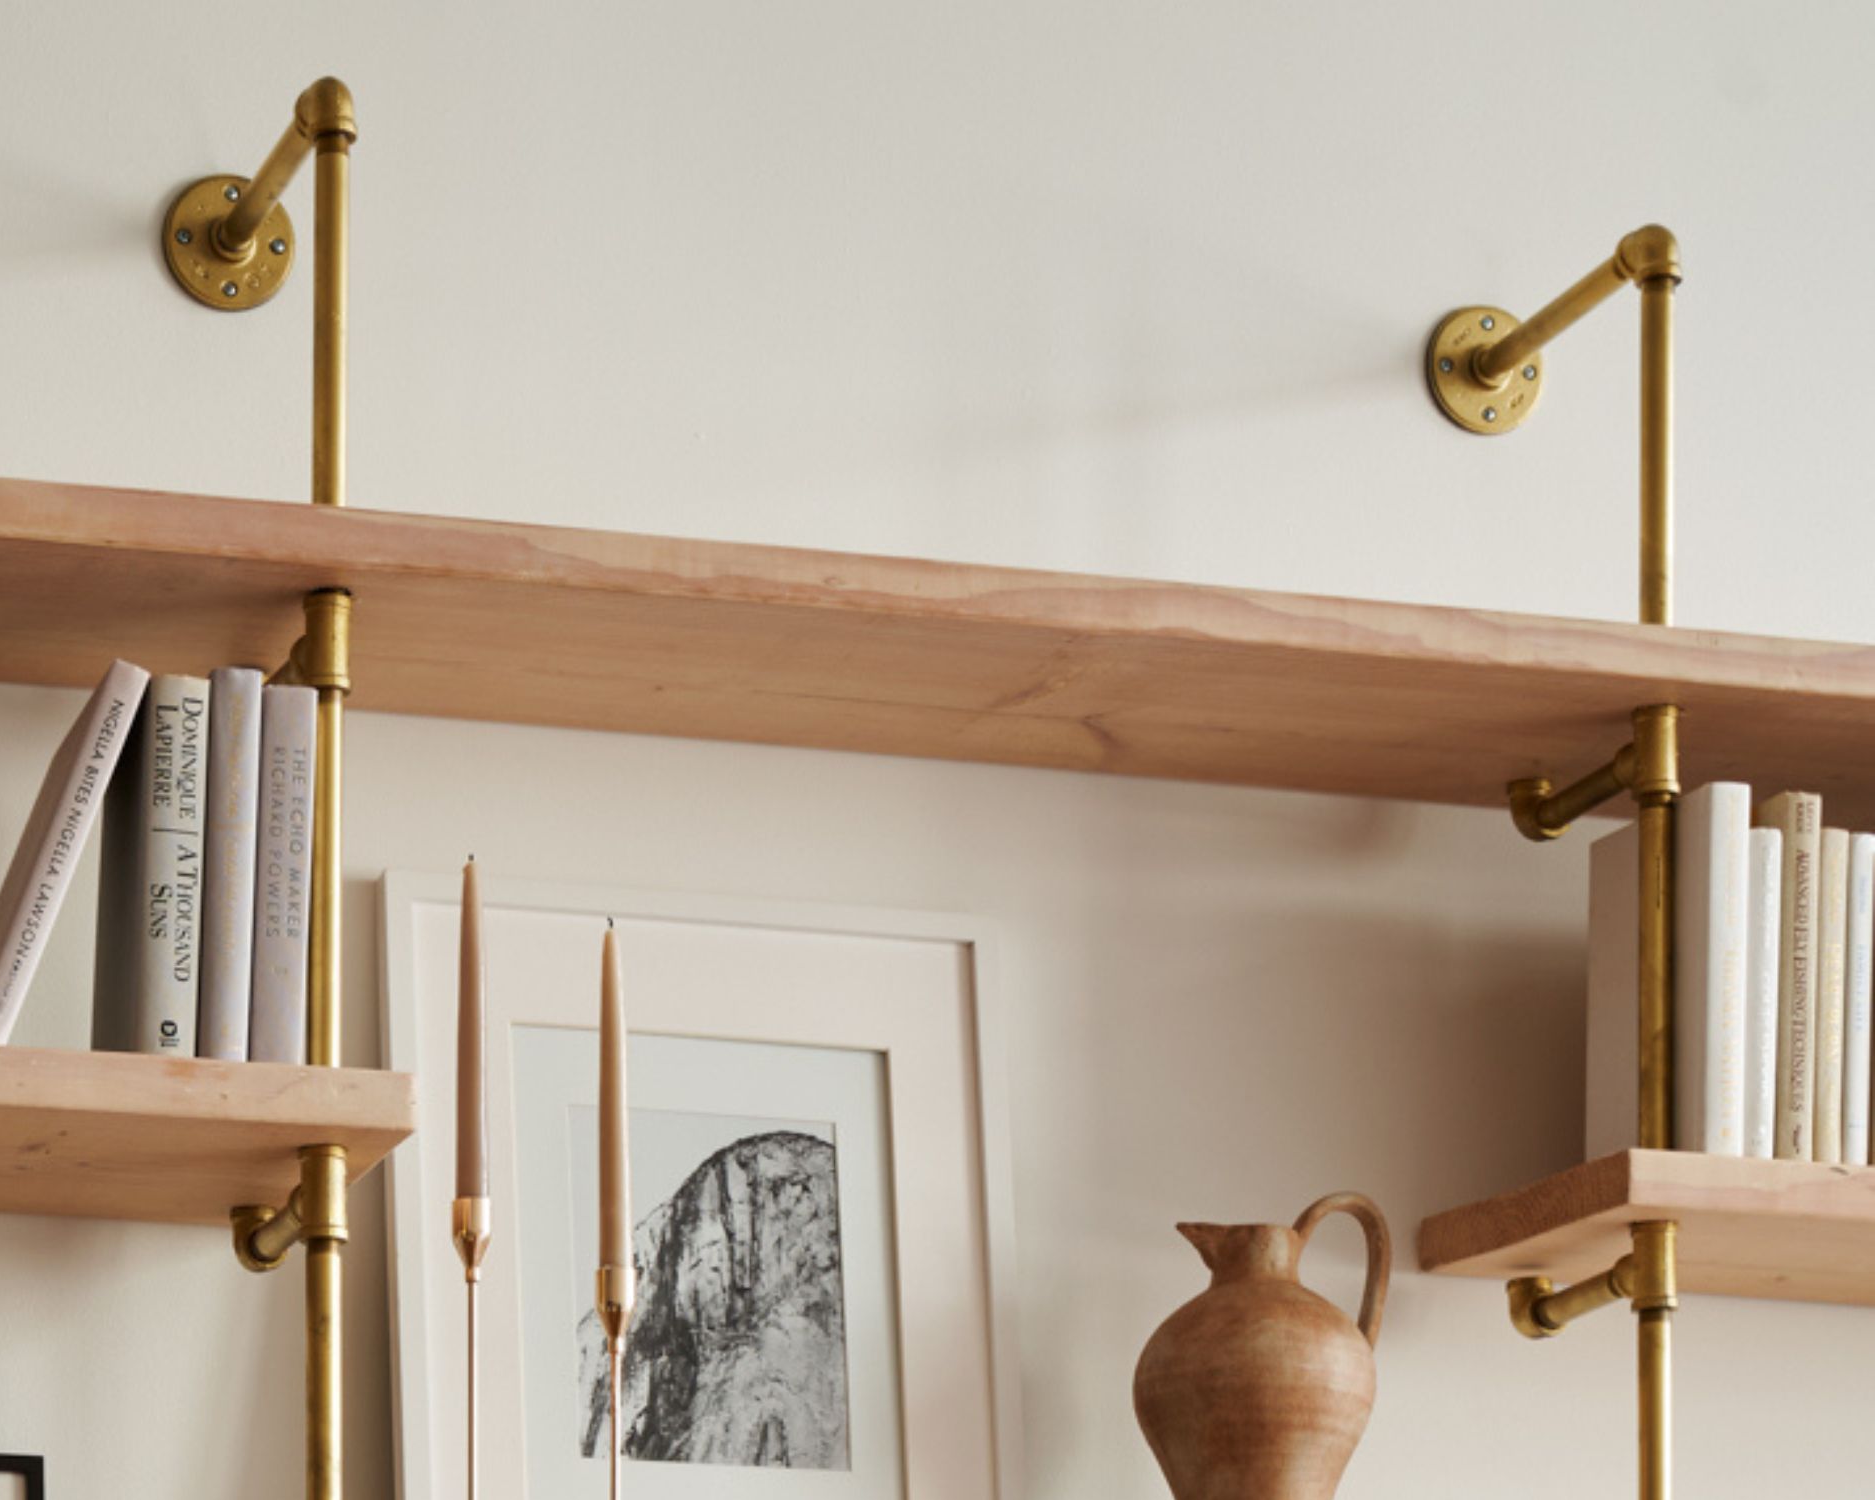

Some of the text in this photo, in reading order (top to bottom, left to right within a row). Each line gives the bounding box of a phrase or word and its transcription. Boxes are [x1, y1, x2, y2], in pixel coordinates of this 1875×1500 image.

[15, 698, 125, 959] NIGELLA BITES NIGELLA LAWSON
[177, 845, 195, 861] A
[264, 745, 285, 939] RICHARD POWERS
[286, 746, 306, 940] THE ECHO MAKER
